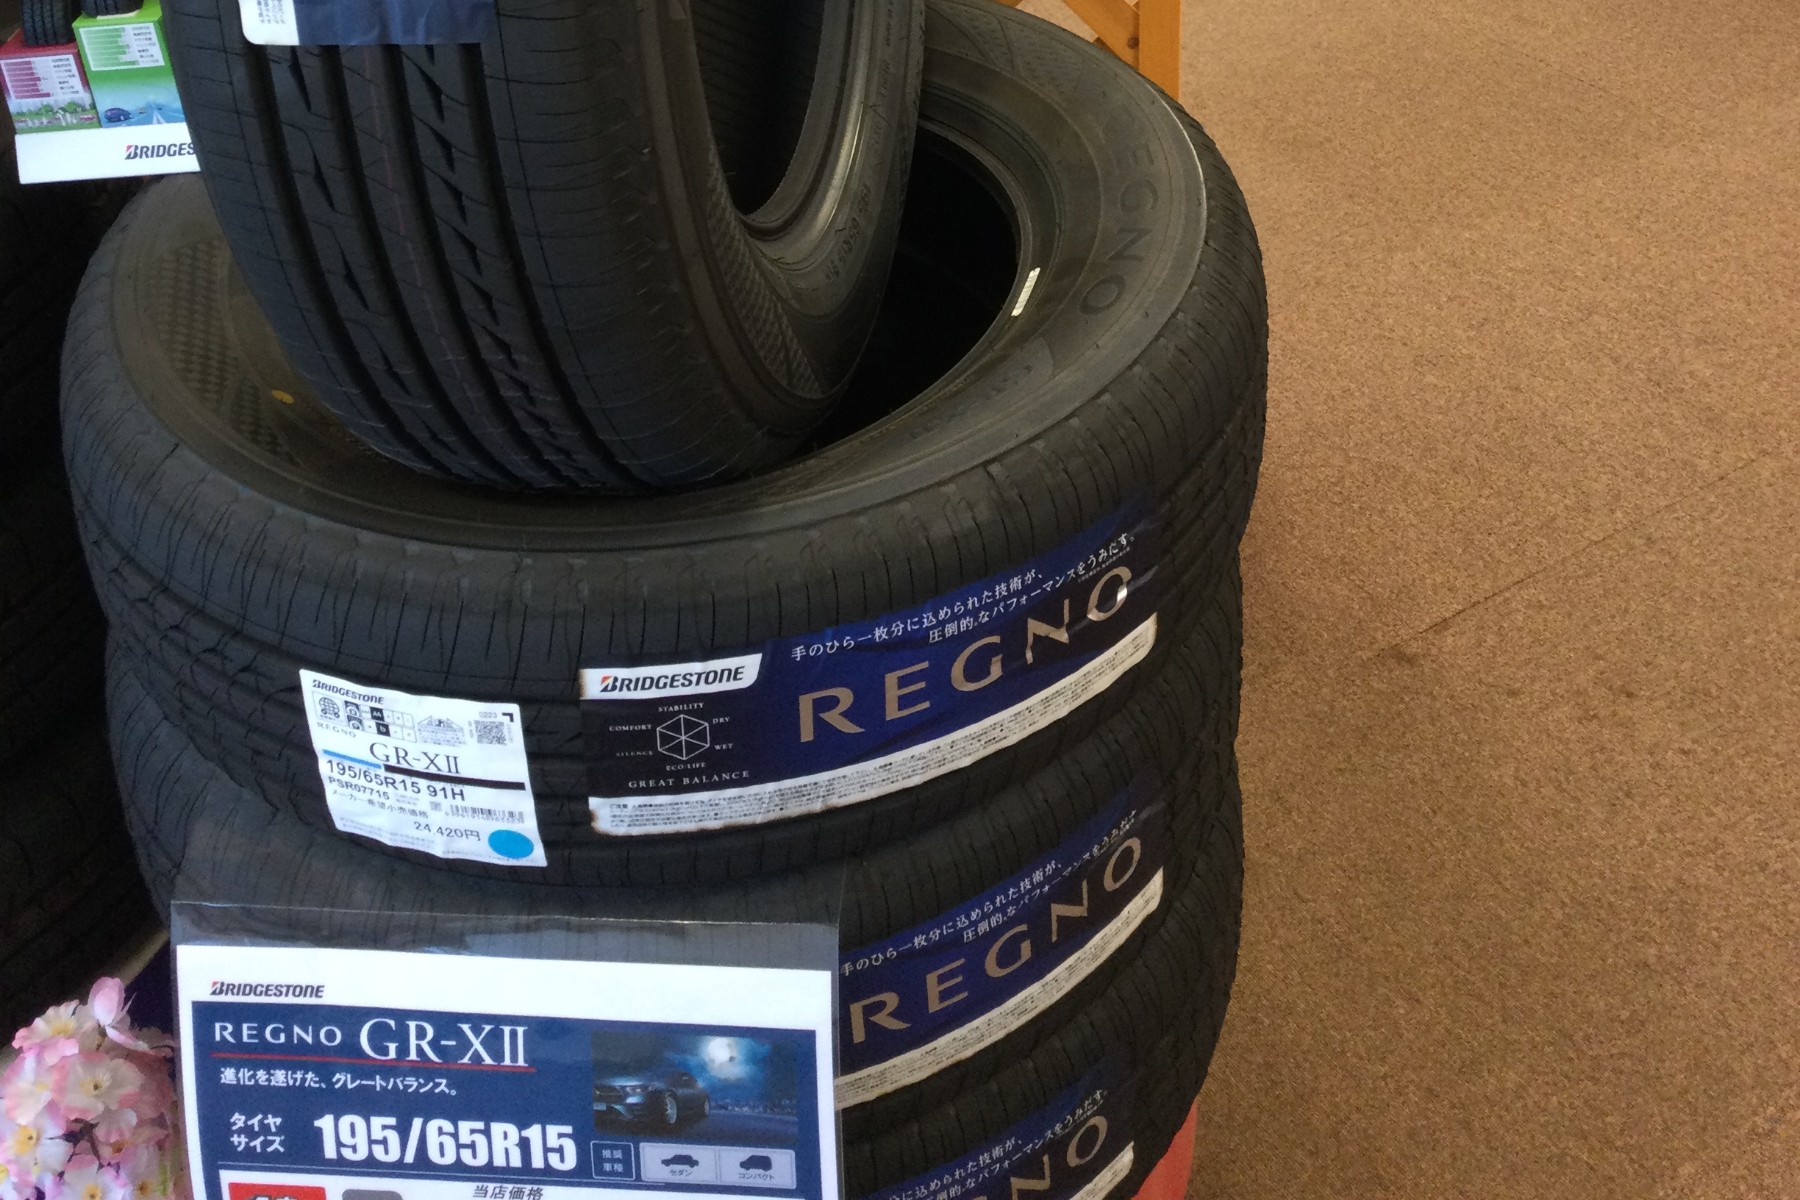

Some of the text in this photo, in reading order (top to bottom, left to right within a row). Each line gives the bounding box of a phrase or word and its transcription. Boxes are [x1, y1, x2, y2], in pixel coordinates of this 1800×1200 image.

[791, 569, 1043, 662] 手のひら一枚分に込められた技術が、
[799, 565, 1133, 743] REGNO
[599, 665, 746, 693] BRIDGESTONE
[311, 678, 385, 705] BRIDGESTONE
[657, 702, 705, 713] STABILITY
[609, 723, 653, 732] COMFORT
[712, 716, 731, 725] DRY
[714, 742, 734, 751] WET
[326, 759, 466, 801] 195/65R15 91H
[328, 776, 390, 801] PSR07715
[628, 770, 751, 789] GREAT BALANCE
[332, 788, 429, 820] メーカー希望小売価格
[413, 820, 481, 842] 24,420円
[840, 859, 1063, 977] 手のひら一枚分に込められた技術が、
[850, 836, 1142, 1045] REGNO
[210, 981, 325, 999] BRIDGESTONE
[214, 1021, 342, 1047] REGNO
[220, 1067, 457, 1097] 進化を遂げた、グレートバランス。
[229, 1112, 283, 1133] タイヤ
[229, 1135, 286, 1154] サイズ
[314, 1113, 578, 1171] 195/65R15
[602, 1161, 625, 1173] 車種
[669, 1168, 776, 1181] セダン コンパクト
[472, 1183, 545, 1200] 当店価格
